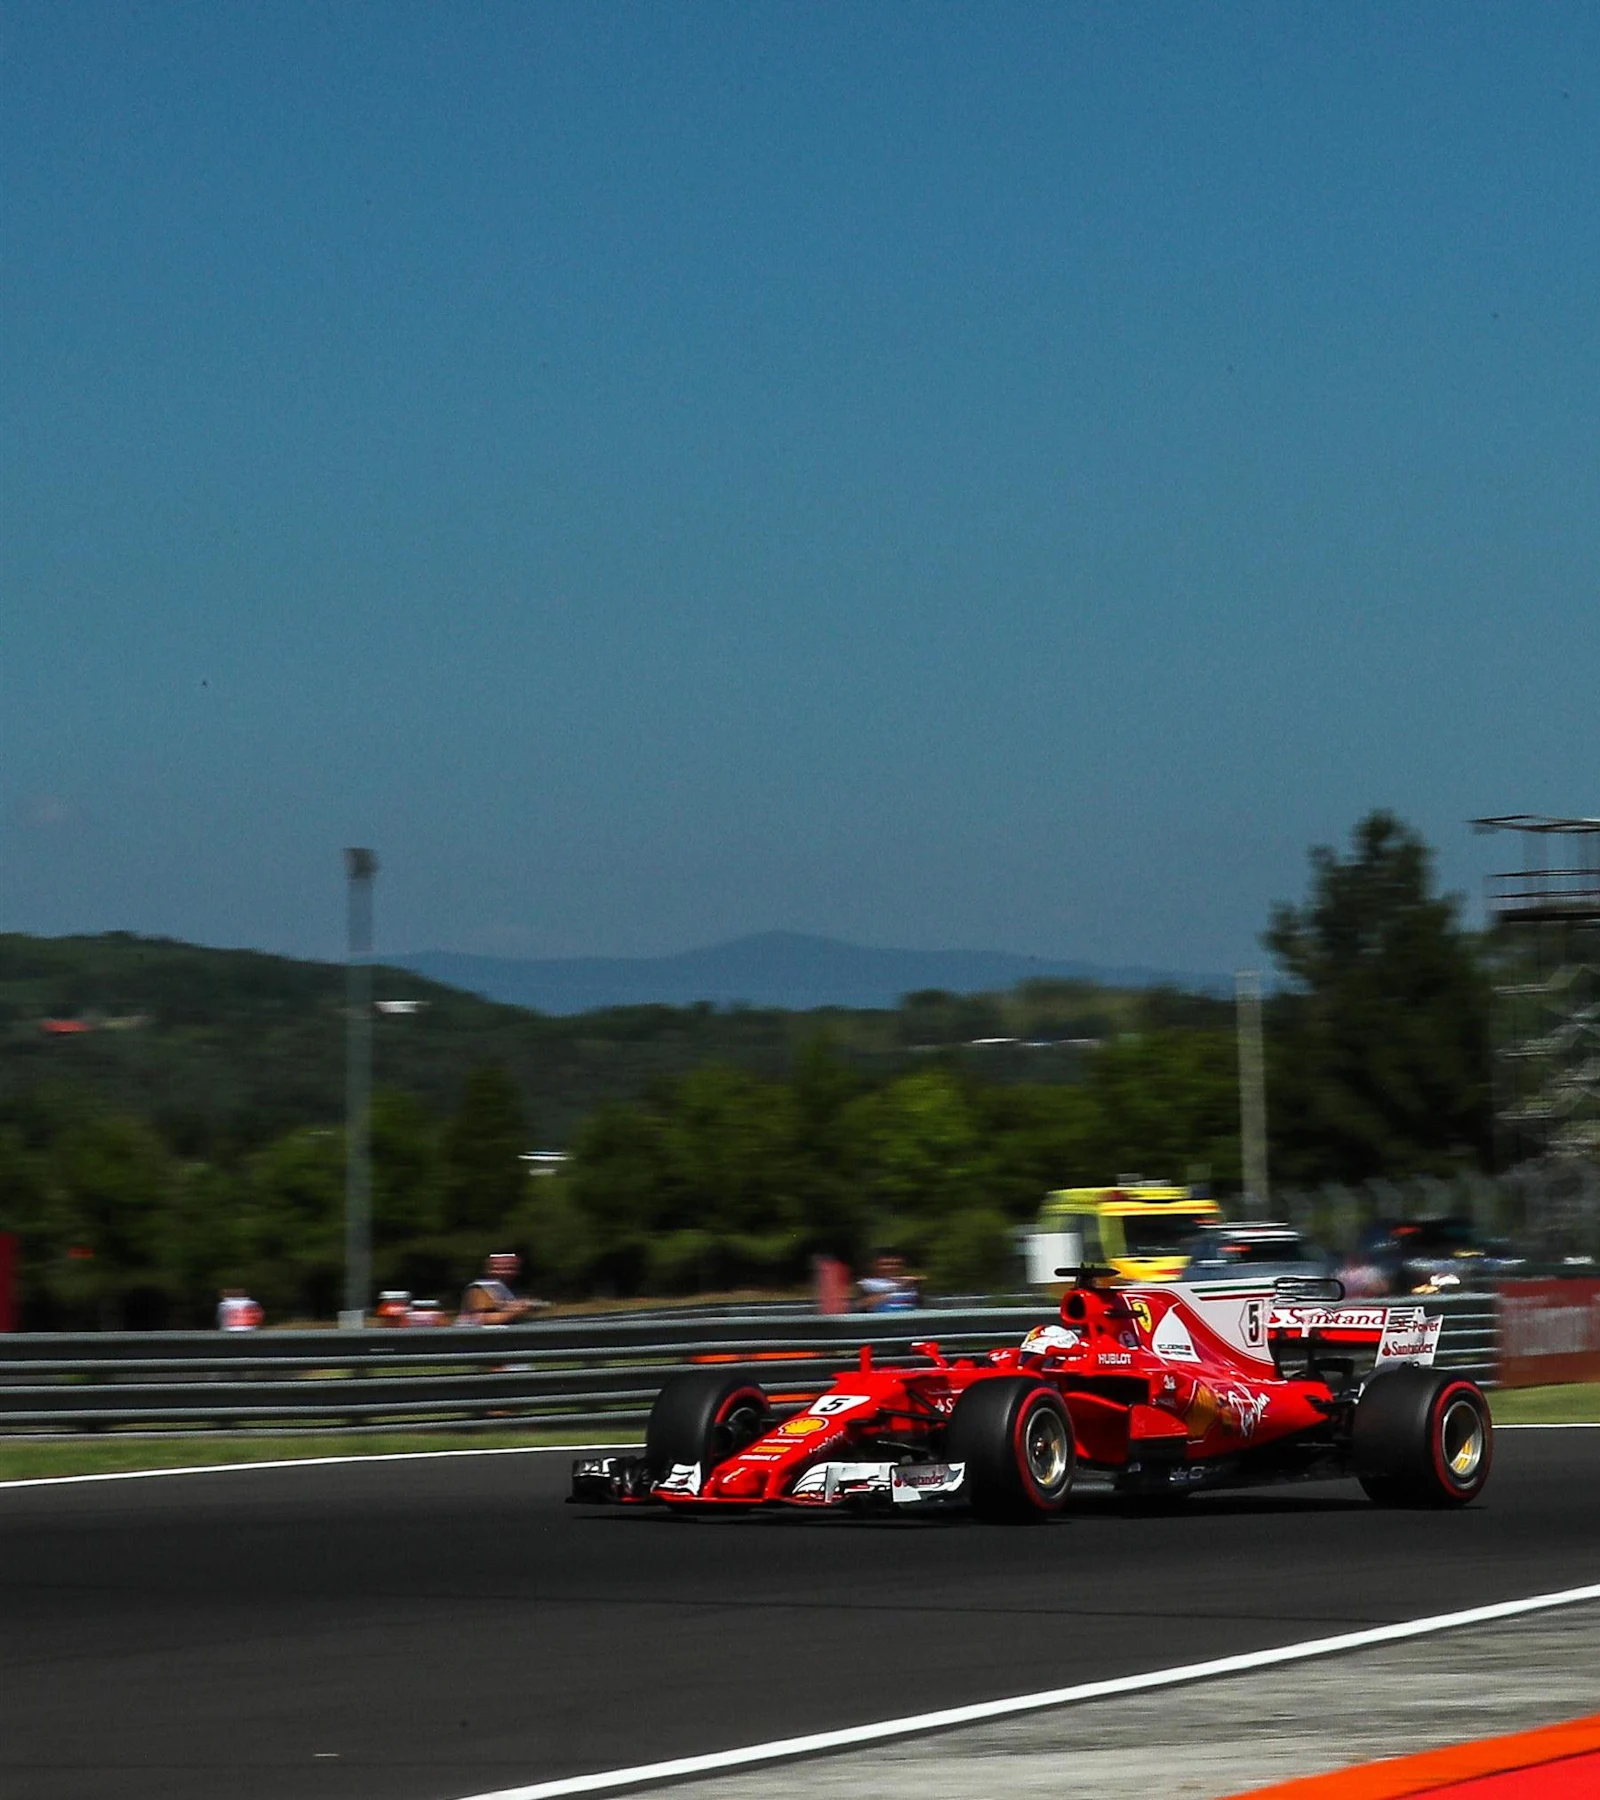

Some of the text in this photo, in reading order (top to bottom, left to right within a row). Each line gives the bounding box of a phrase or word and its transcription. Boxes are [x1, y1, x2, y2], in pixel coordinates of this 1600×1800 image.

[1249, 1304, 1258, 1342] 5
[1098, 1354, 1131, 1364] HUBLOT
[820, 1397, 852, 1412] 5
